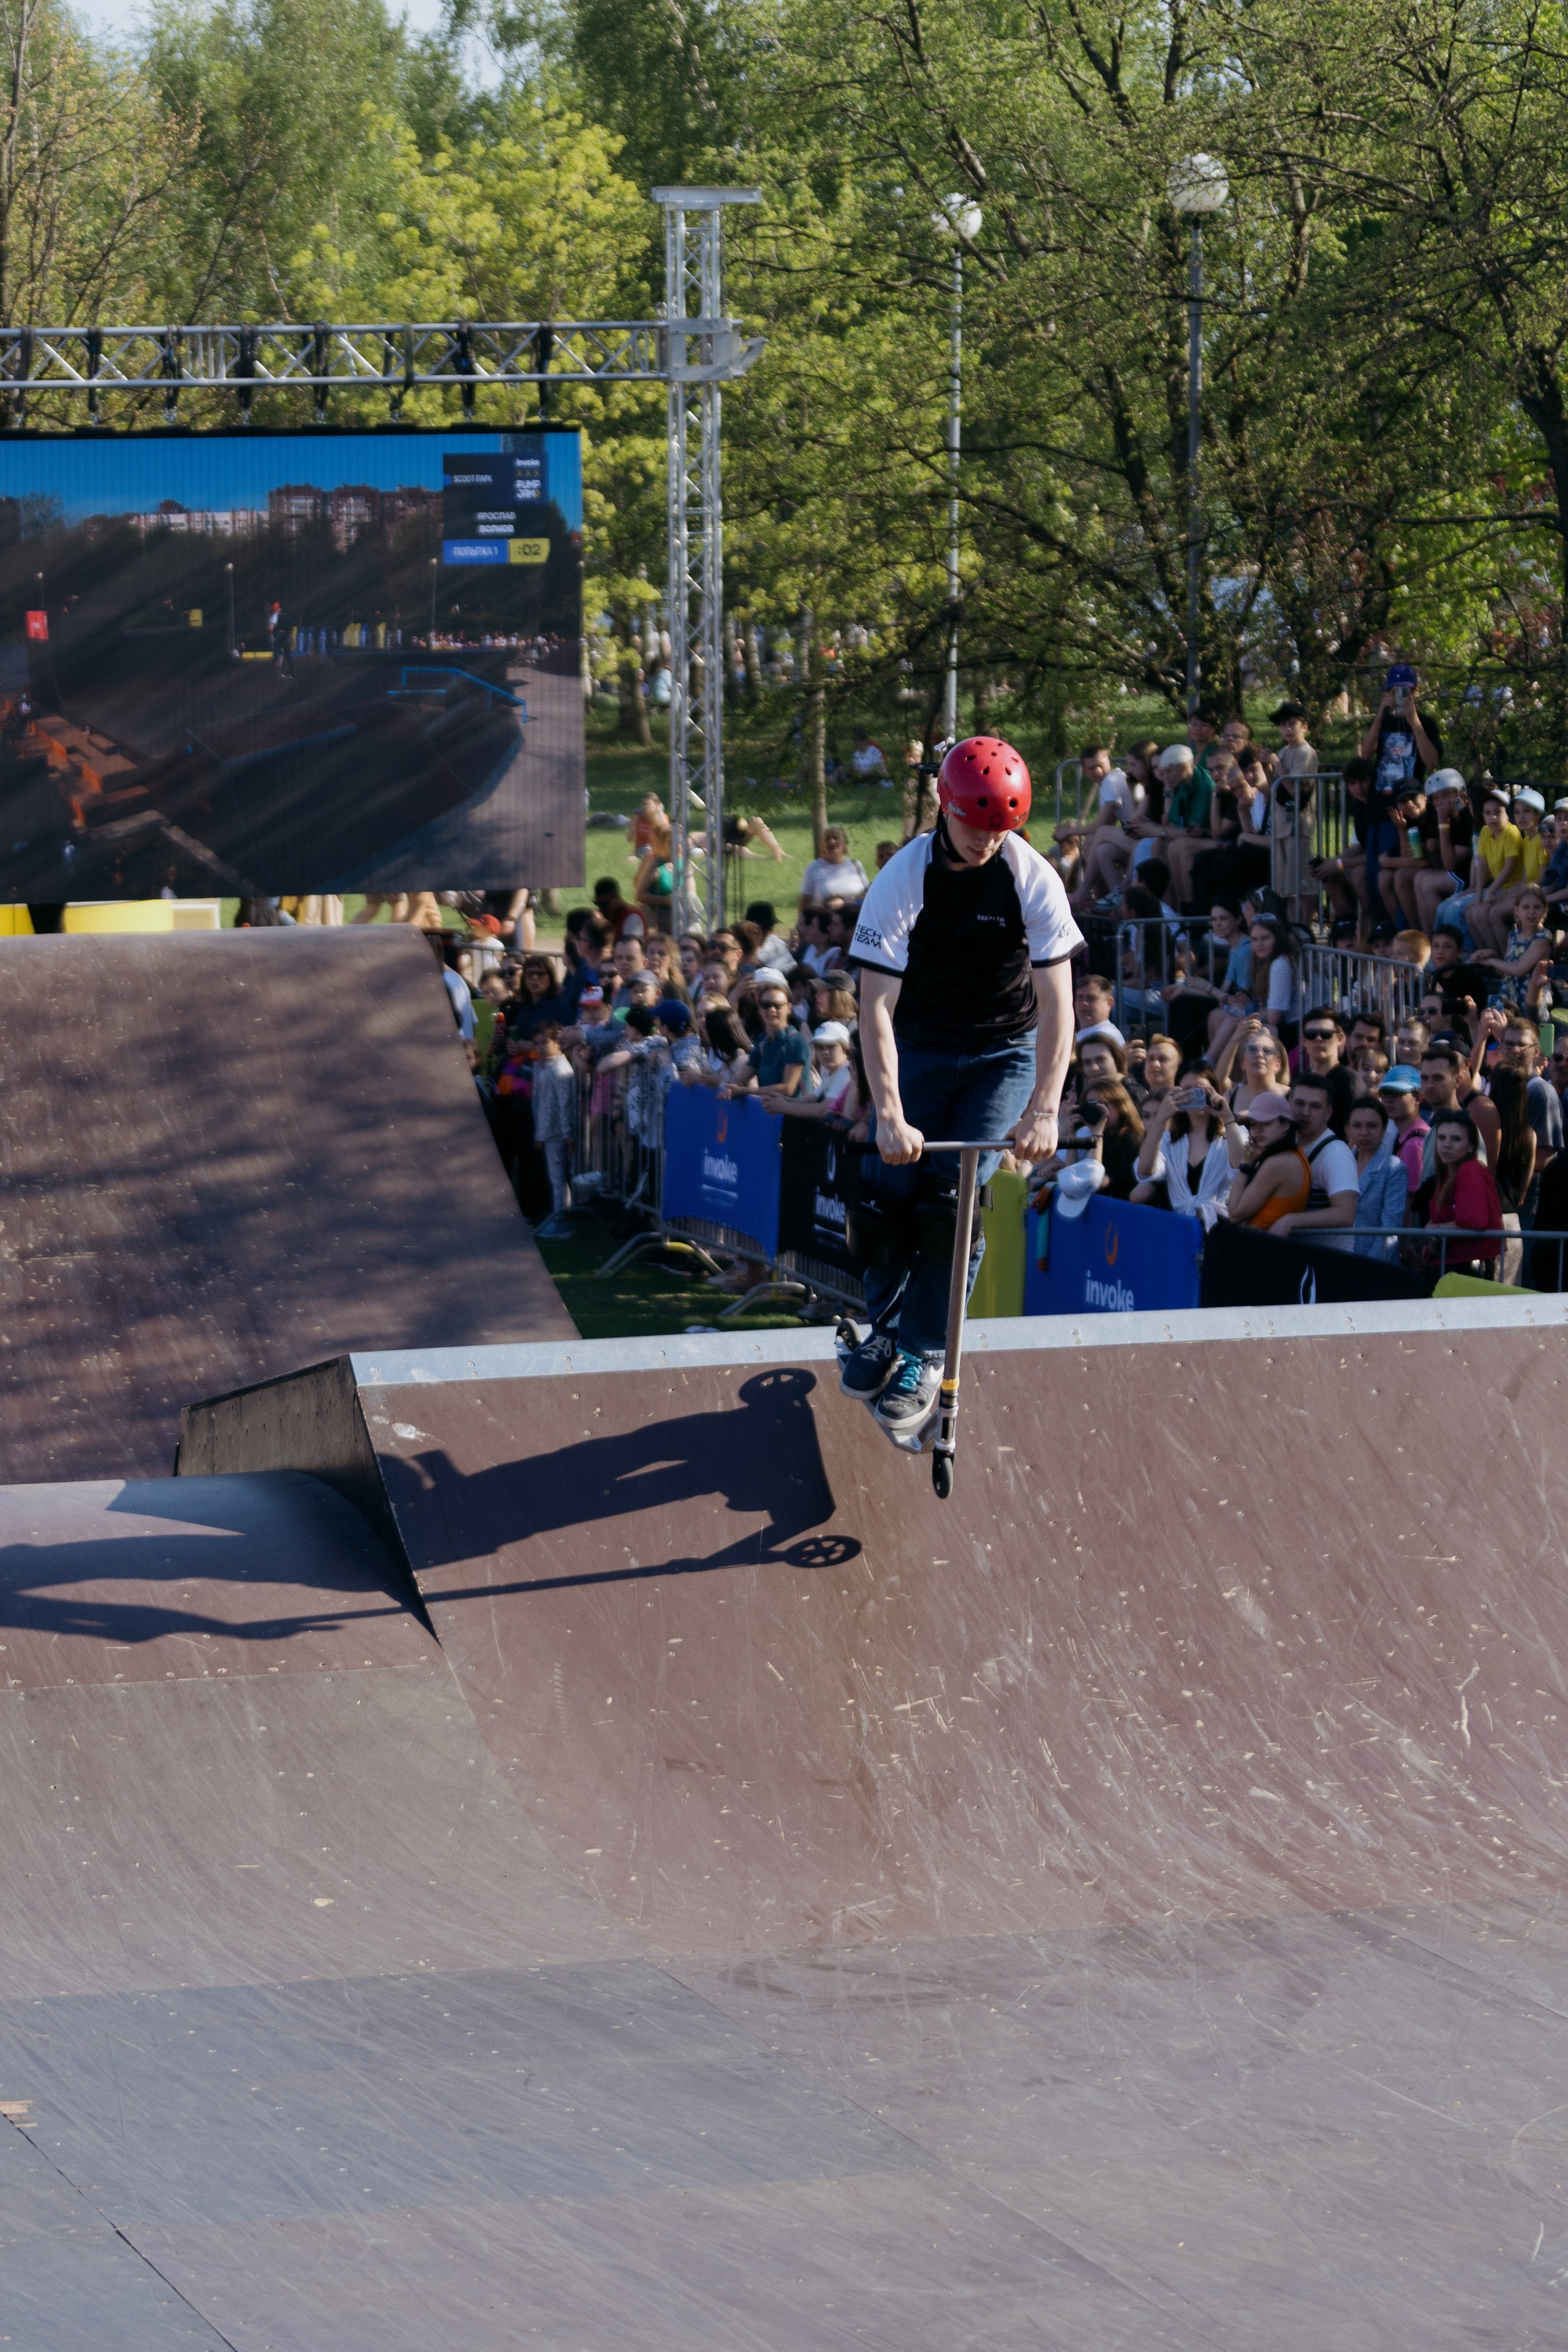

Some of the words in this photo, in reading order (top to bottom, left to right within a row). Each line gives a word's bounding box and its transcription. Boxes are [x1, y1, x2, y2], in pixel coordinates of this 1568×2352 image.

[477, 511, 516, 521] ЯРОСЛАВ
[478, 524, 514, 533] ВОЛКОВ
[453, 546, 493, 556] ПОПЫТКА
[858, 924, 881, 940] TECH
[854, 932, 881, 949] TEAM
[704, 1147, 737, 1183] invoke
[816, 1185, 845, 1224] invoke
[1086, 1269, 1134, 1312] invoke
